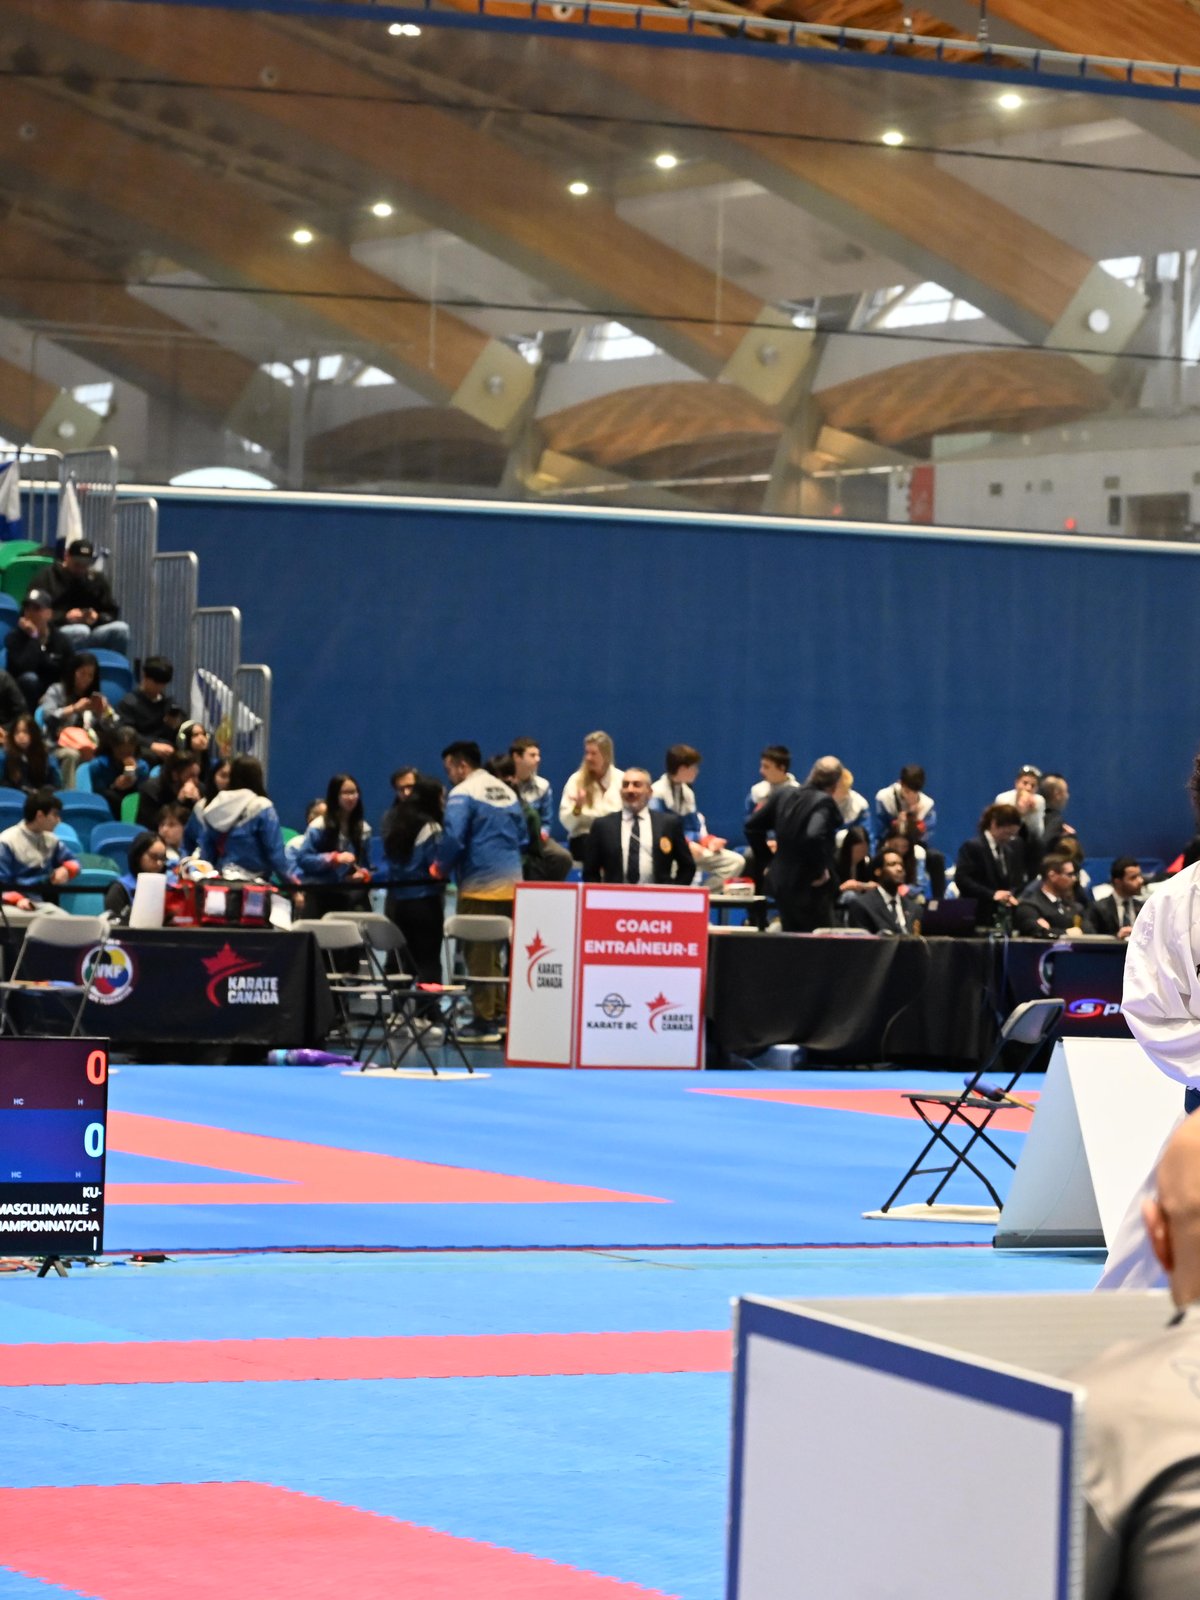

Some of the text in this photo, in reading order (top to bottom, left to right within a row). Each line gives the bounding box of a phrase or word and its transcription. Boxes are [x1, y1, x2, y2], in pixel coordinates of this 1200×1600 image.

[615, 918, 672, 934] COACH
[538, 963, 563, 976] KARATE
[227, 976, 278, 991] KARATE
[536, 976, 563, 989] CANADA
[227, 990, 279, 1005] CANADA
[662, 1014, 694, 1022] KARATE
[586, 1021, 638, 1030] KARATE BC
[661, 1022, 694, 1032] CANADA
[86, 1050, 106, 1085] 0
[83, 1122, 104, 1157] 0
[82, 1187, 102, 1198] KU-
